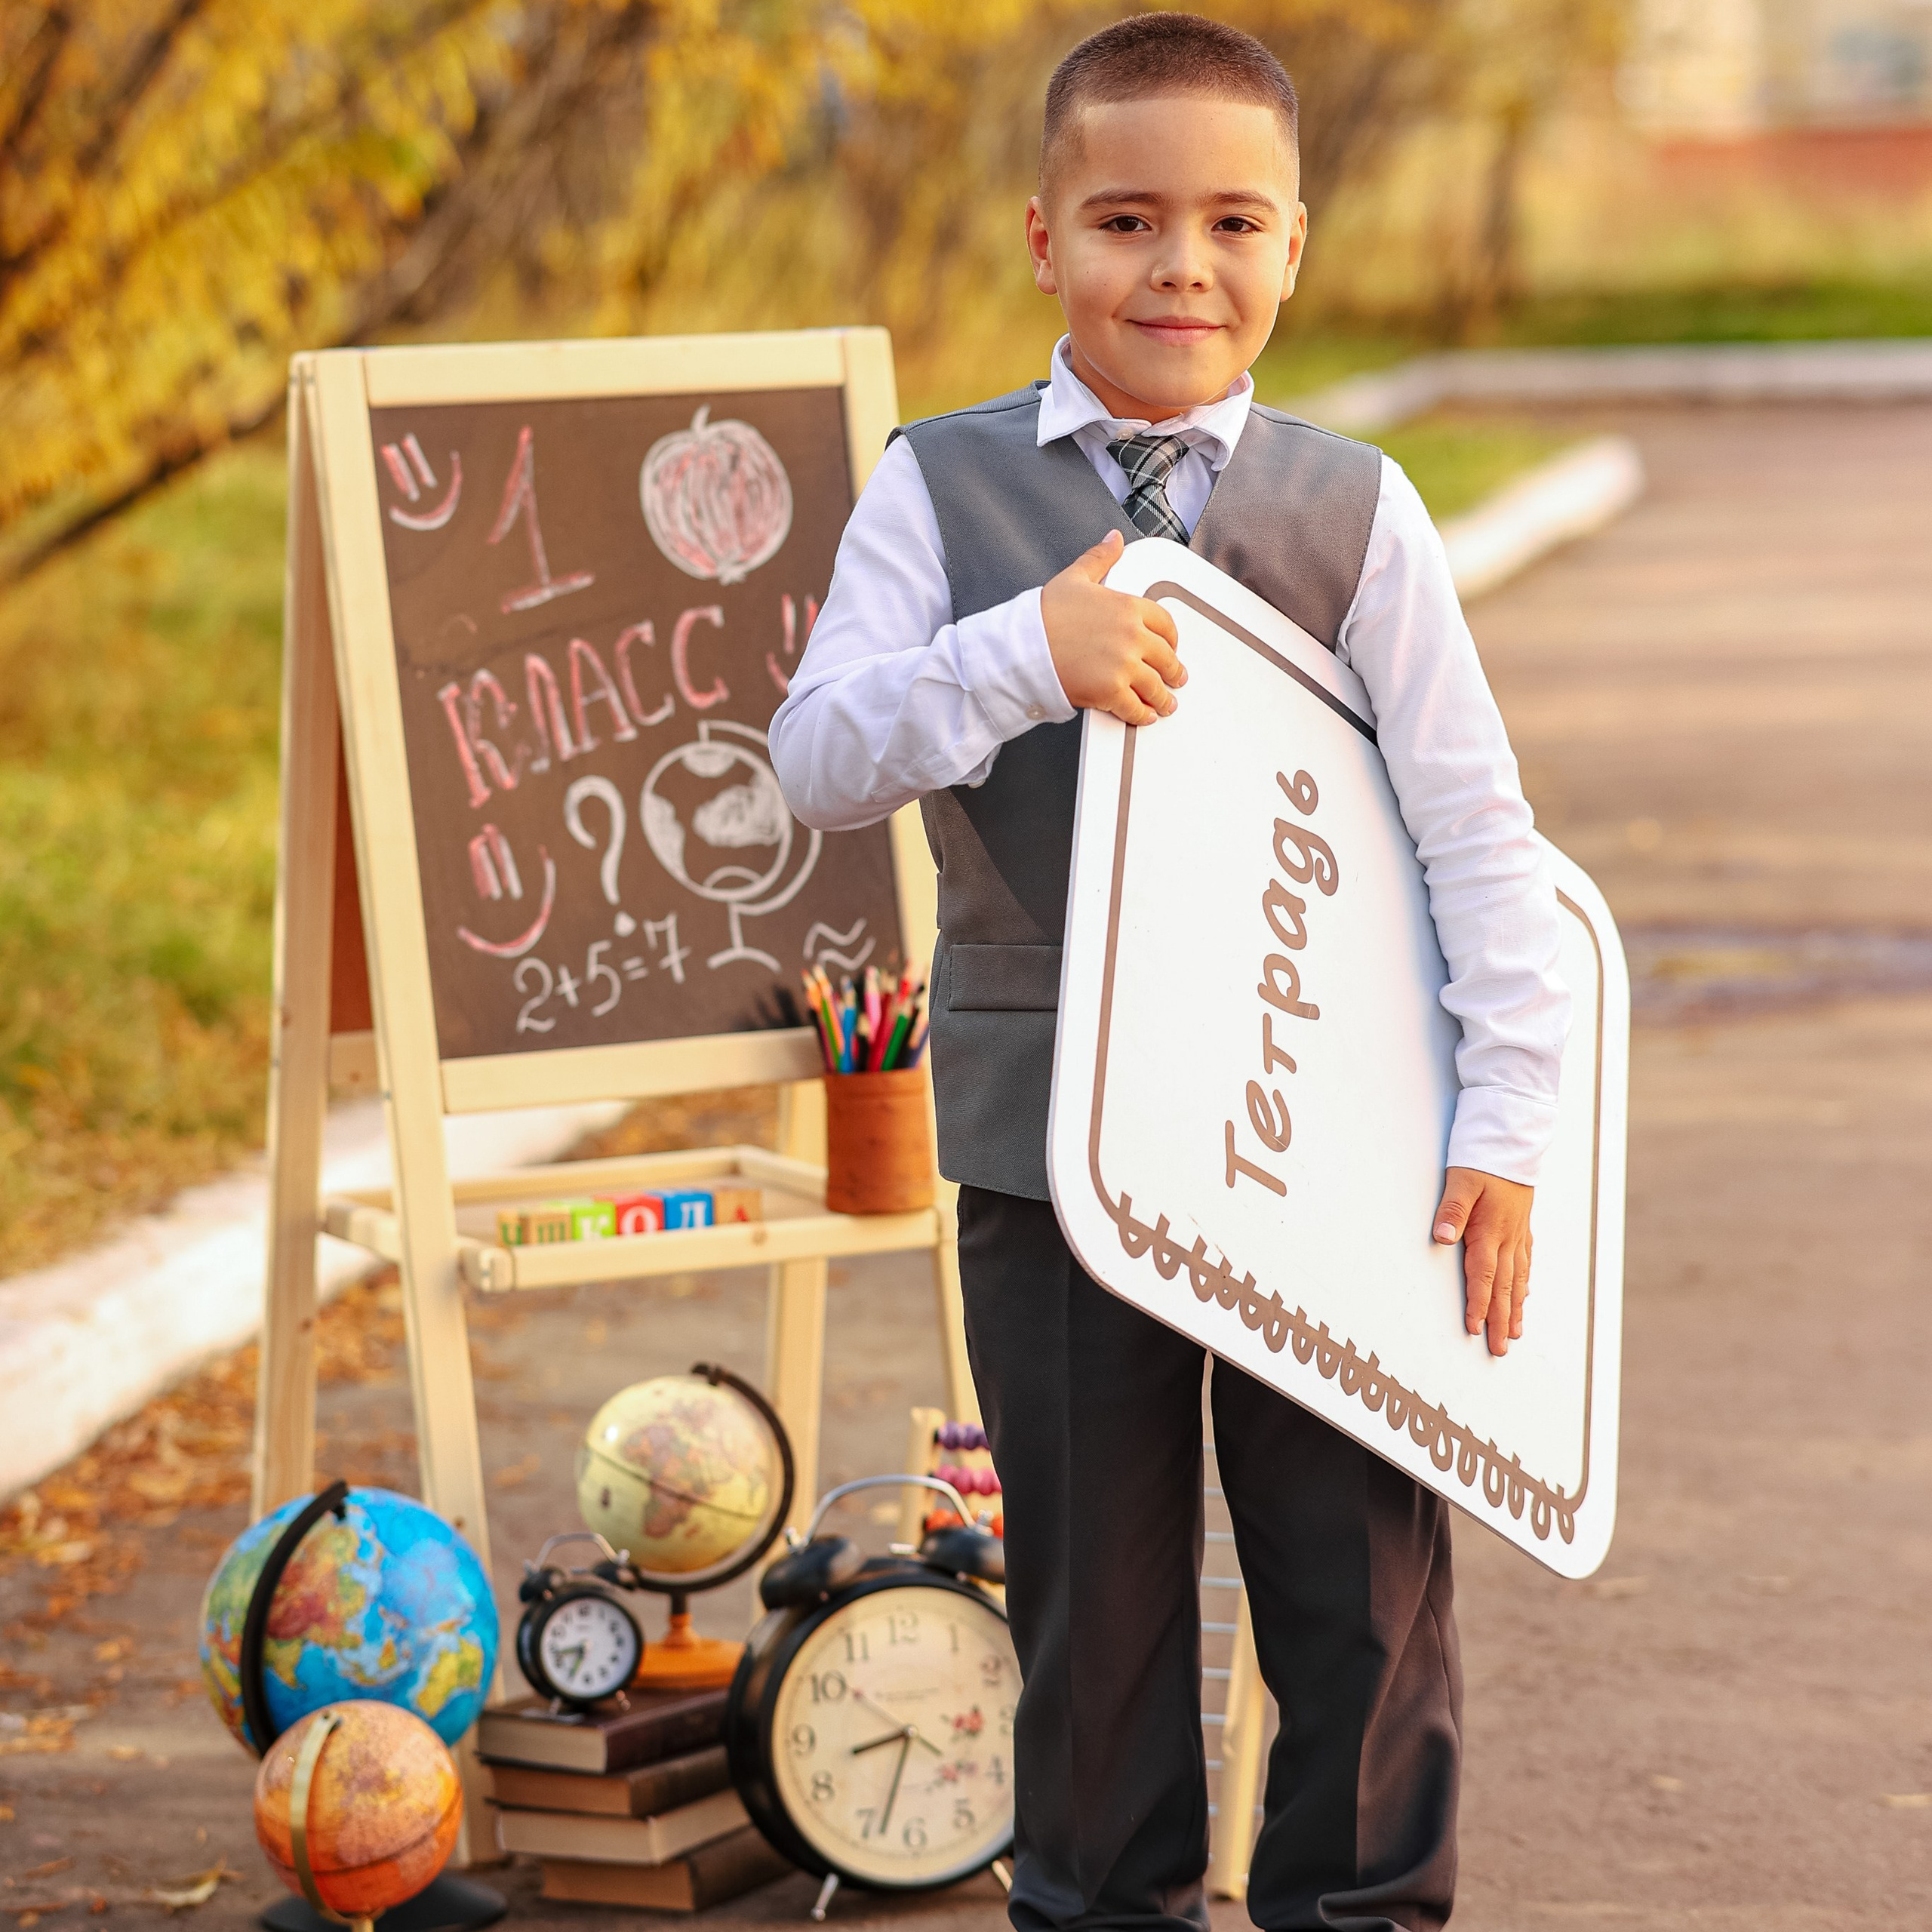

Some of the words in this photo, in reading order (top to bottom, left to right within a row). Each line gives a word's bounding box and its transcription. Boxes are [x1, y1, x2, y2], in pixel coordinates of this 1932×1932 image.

[487, 426, 595, 614] 1
[437, 605, 731, 809] КЛАСС
[512, 910, 692, 1034] 2+5=7
[1225, 768, 1340, 1198] Тетрадь
[888, 1612, 919, 1645] 12
[949, 1622, 960, 1654] 1
[845, 1632, 871, 1663] 11
[811, 1669, 847, 1703] 10
[792, 1723, 816, 1758] 9
[811, 1770, 835, 1802] 8
[854, 1807, 875, 1840] 7
[952, 1797, 975, 1830] 5
[903, 1816, 928, 1849] 6
